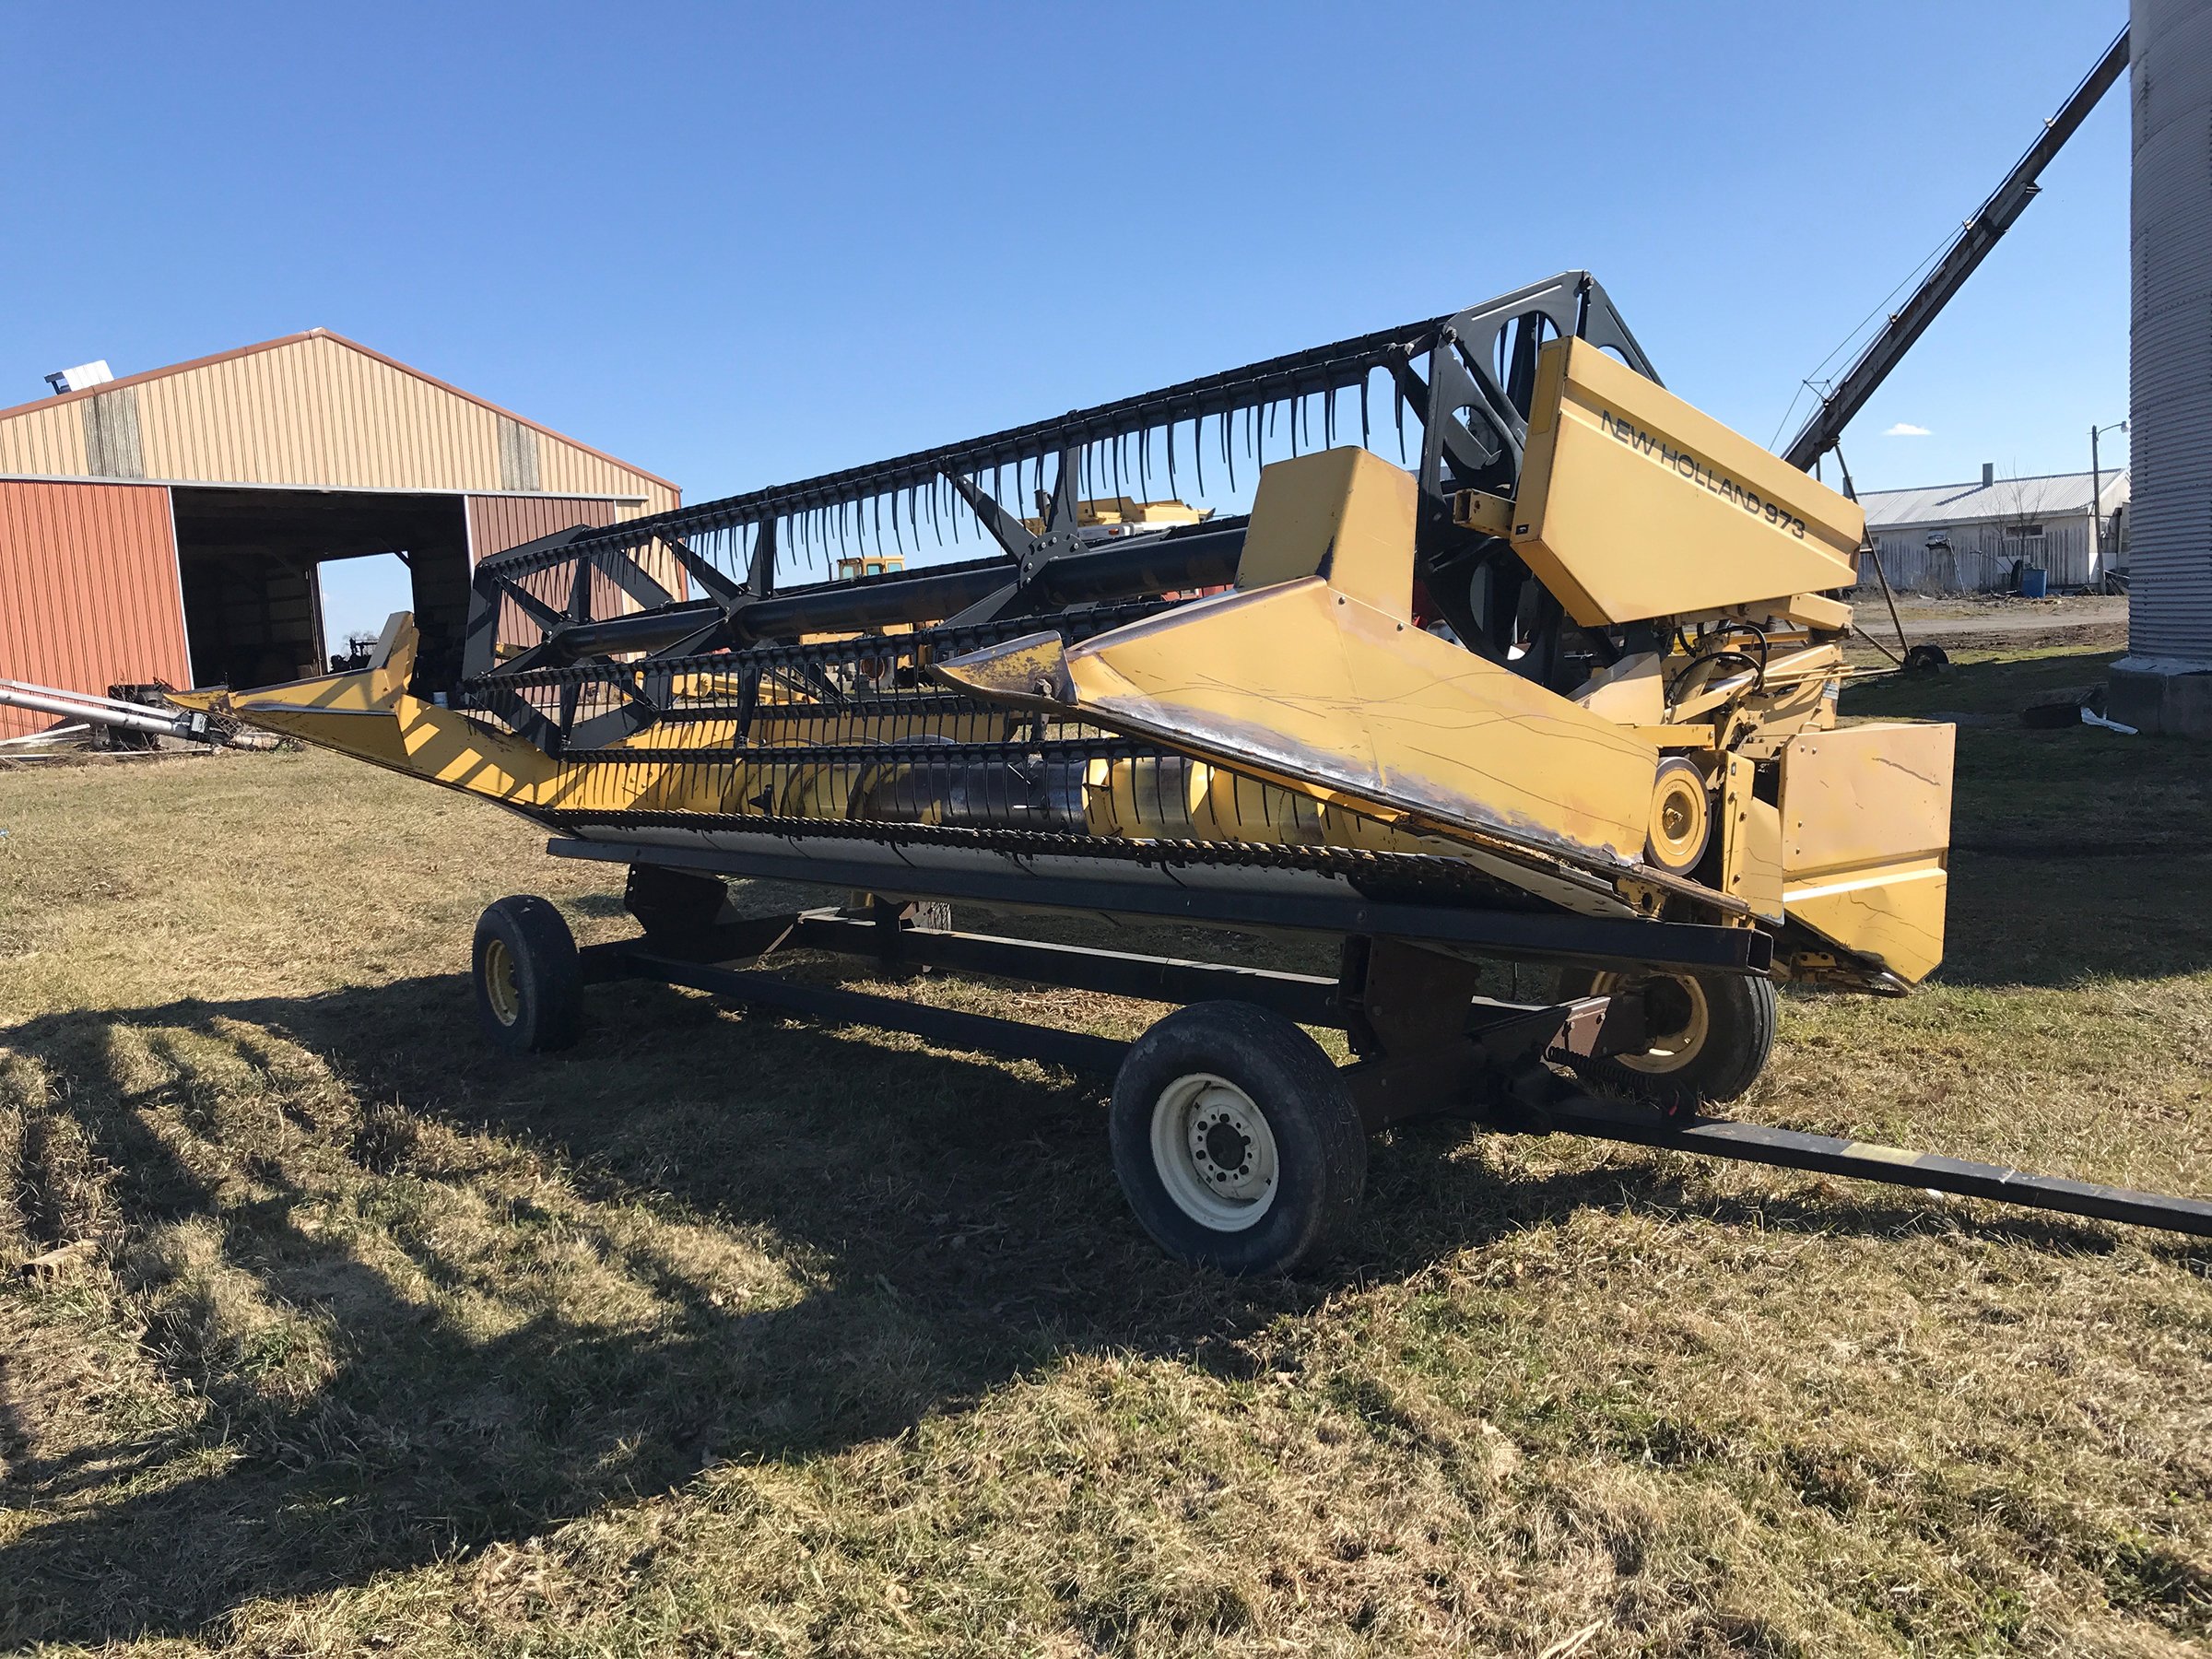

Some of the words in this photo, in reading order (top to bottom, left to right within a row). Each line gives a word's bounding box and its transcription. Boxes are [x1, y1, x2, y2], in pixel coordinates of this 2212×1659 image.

[1601, 409, 1656, 456] NEW
[1661, 443, 1760, 514] HOLLAND
[1764, 502, 1806, 540] 973
